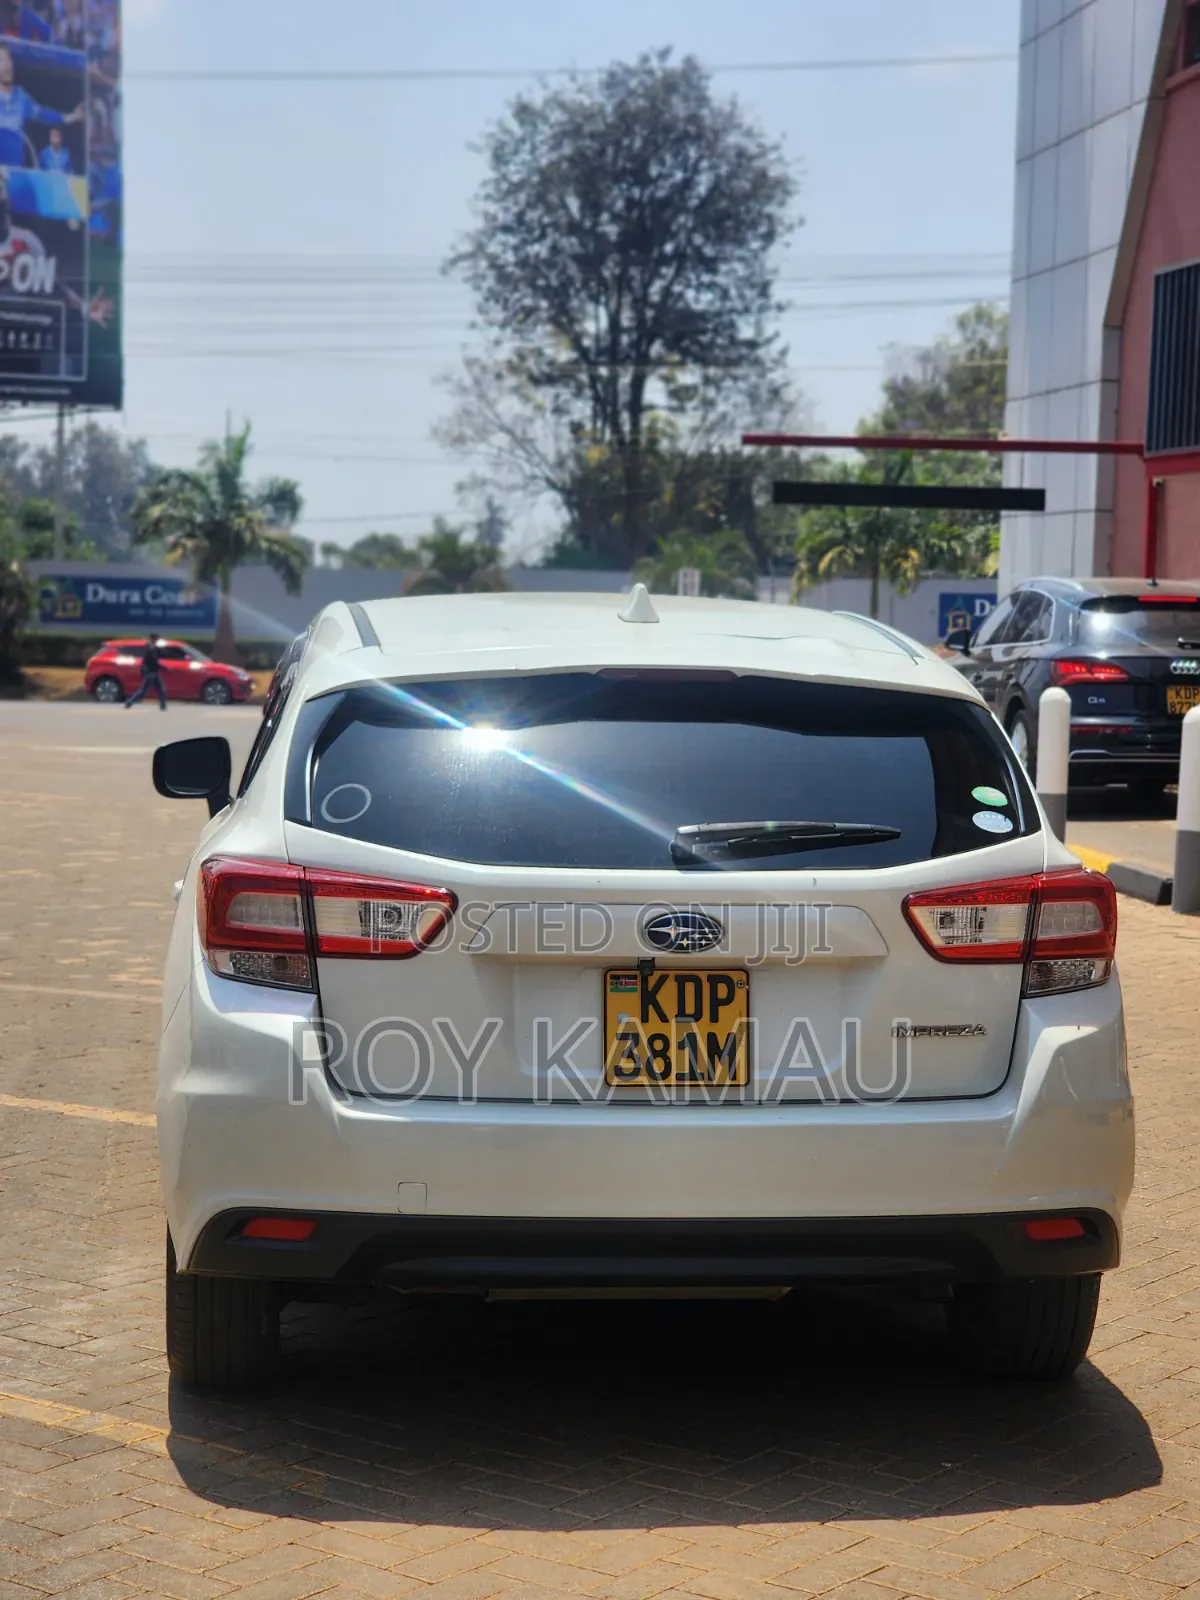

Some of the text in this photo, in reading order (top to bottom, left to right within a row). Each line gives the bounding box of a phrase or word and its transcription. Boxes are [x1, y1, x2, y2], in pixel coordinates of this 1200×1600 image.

[86, 583, 141, 605] Dura
[1170, 701, 1198, 714] 877
[641, 974, 736, 1023] KDP
[891, 1023, 988, 1038] IMPREZA
[613, 1032, 737, 1081] 381M
